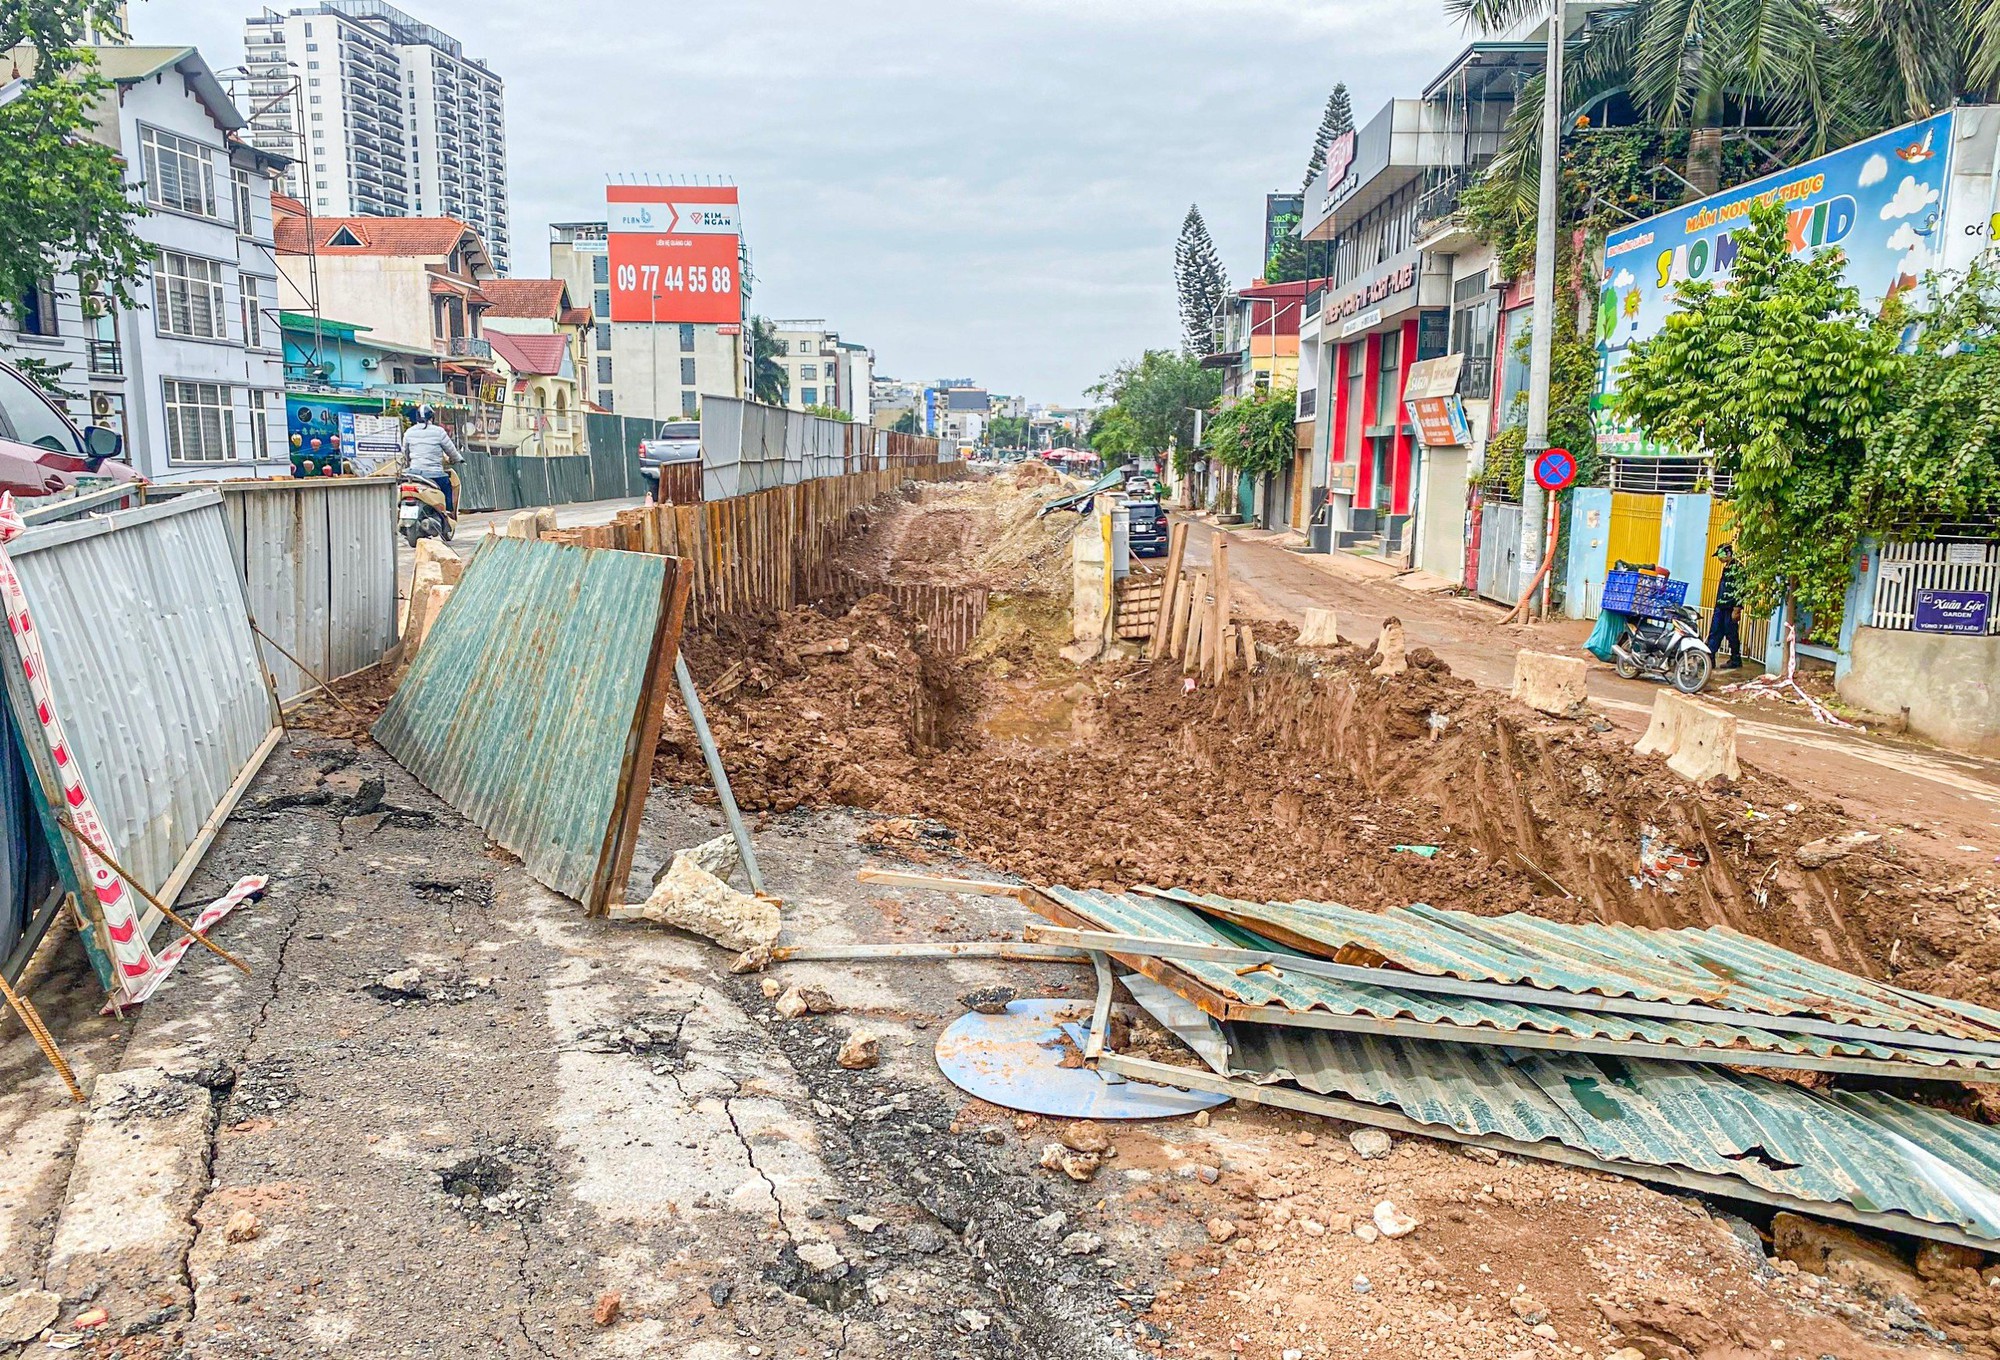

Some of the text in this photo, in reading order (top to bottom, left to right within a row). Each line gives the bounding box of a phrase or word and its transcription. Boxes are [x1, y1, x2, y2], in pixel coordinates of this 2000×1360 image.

[1718, 197, 1751, 224] NON
[1778, 173, 1825, 203] THỤC
[1656, 237, 1709, 289] SAO
[1785, 194, 1858, 254] KID
[617, 264, 731, 293] 09 77 44 55 88
[1932, 598, 1985, 613] Xuân Lộc
